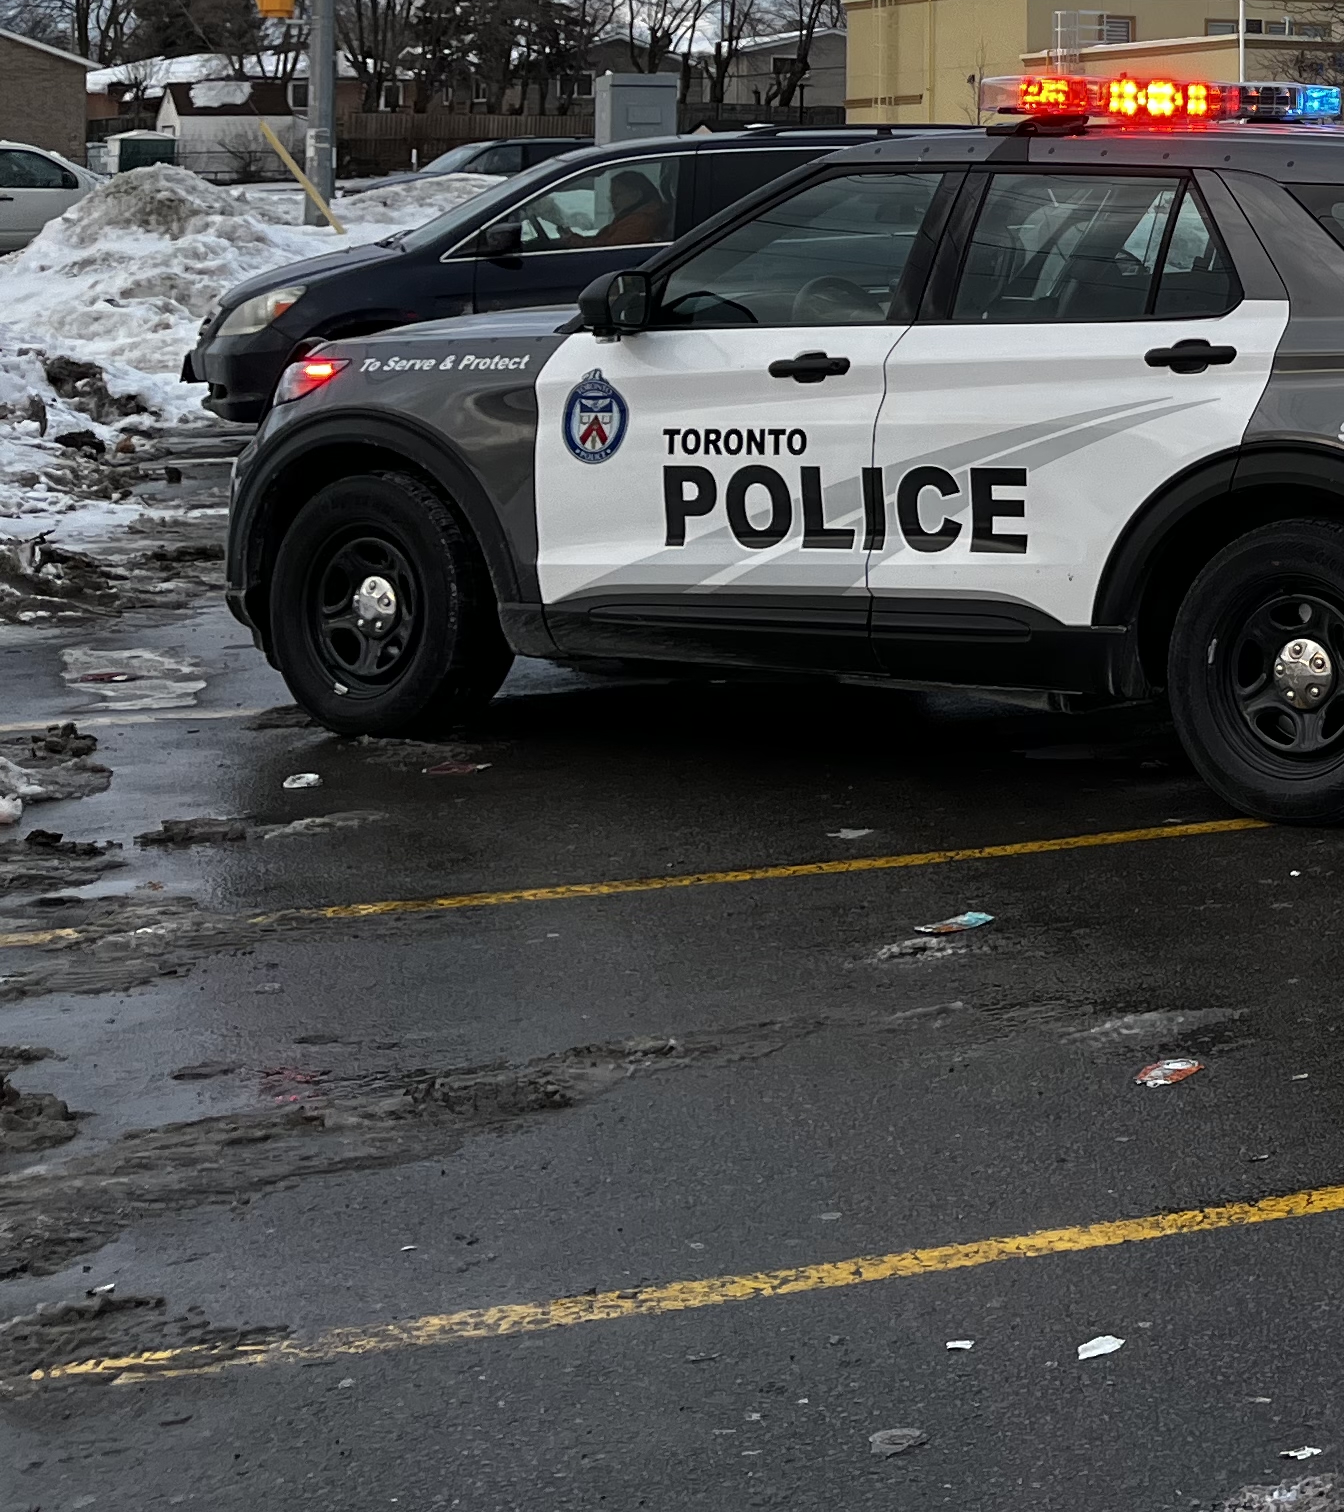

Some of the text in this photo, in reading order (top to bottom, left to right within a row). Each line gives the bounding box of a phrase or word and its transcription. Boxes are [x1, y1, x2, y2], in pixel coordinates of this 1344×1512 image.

[360, 354, 530, 372] To Serve & Protect
[663, 428, 807, 455] TORONTO
[663, 464, 1028, 554] POLICE
